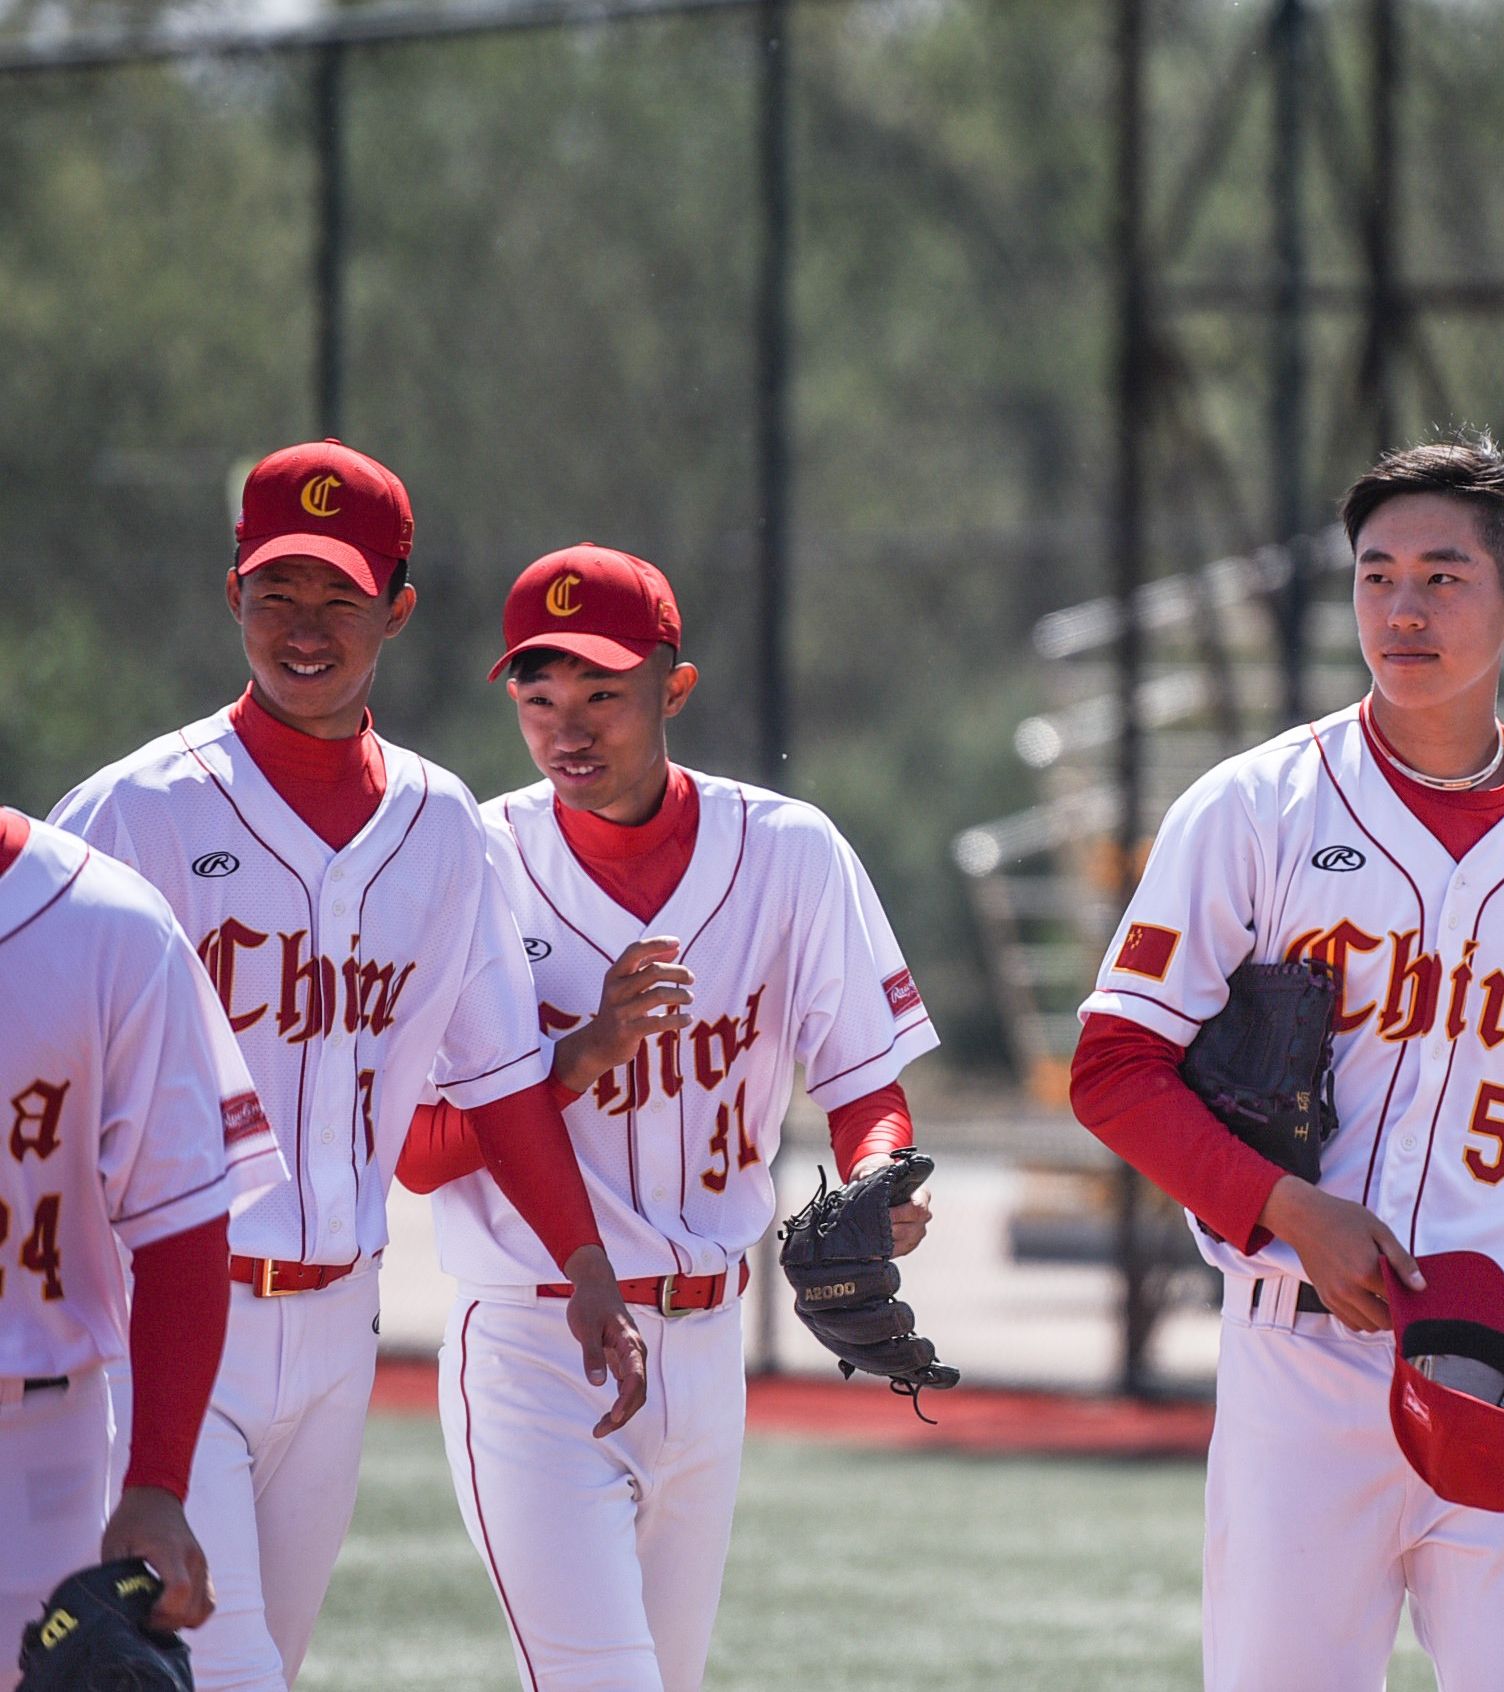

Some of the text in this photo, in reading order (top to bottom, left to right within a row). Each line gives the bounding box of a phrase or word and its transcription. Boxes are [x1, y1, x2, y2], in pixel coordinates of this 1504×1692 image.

[300, 475, 342, 517] C
[545, 574, 584, 617] C
[699, 1077, 763, 1196] 31
[804, 1281, 857, 1302] A2000
